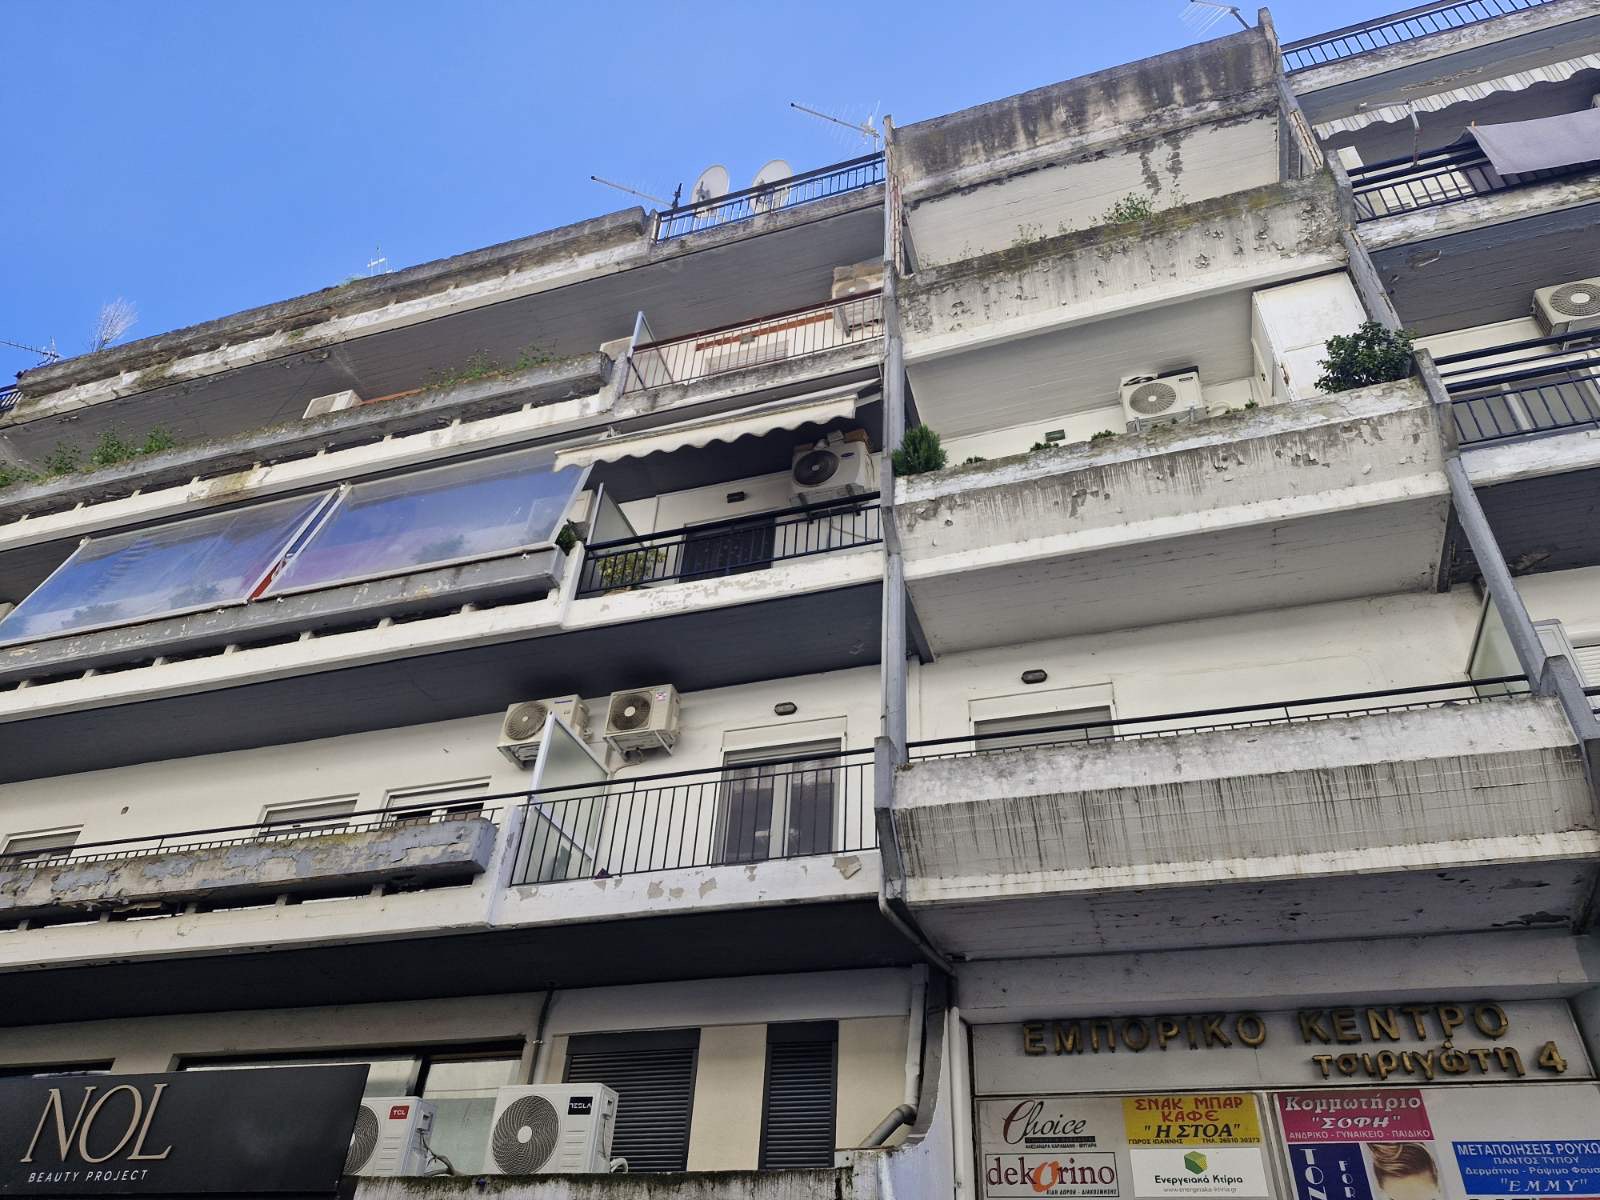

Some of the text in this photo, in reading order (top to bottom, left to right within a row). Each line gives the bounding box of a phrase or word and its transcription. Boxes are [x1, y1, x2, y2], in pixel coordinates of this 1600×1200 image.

[1022, 1002, 1509, 1056] ΕΜΠΟΡΙΚΟ ΚΕΝΤΡΟ
[1537, 1040, 1567, 1074] 4
[1135, 1096, 1244, 1111] ΣΝΑΚ ΜΠΑΡ
[1285, 1093, 1421, 1113] Κομμωτήριο
[20, 1083, 172, 1163] NOL
[1002, 1098, 1087, 1145] Choice
[1161, 1110, 1219, 1122] ΚΑΦΕ
[1289, 1131, 1329, 1139] ΑΝΔΡΙΚΟ
[1336, 1130, 1384, 1138] ΓΥΝΑΙΚΕΙΟ
[1392, 1129, 1431, 1138] ΠΑΙΔΙΚΟ
[1457, 1143, 1553, 1156] ΜΕΤΑΠΟΙΗΣΕΙΣ
[1493, 1156, 1580, 1165] ΠΑΝΤΟΣ ΤΥΠΟΥ
[28, 1169, 148, 1183] BEAUTY PROJECT
[987, 1156, 1115, 1192] dekorino
[1465, 1167, 1519, 1176] Δερμάτινα
[1154, 1175, 1243, 1186] Ενεργειακά Κτίρια
